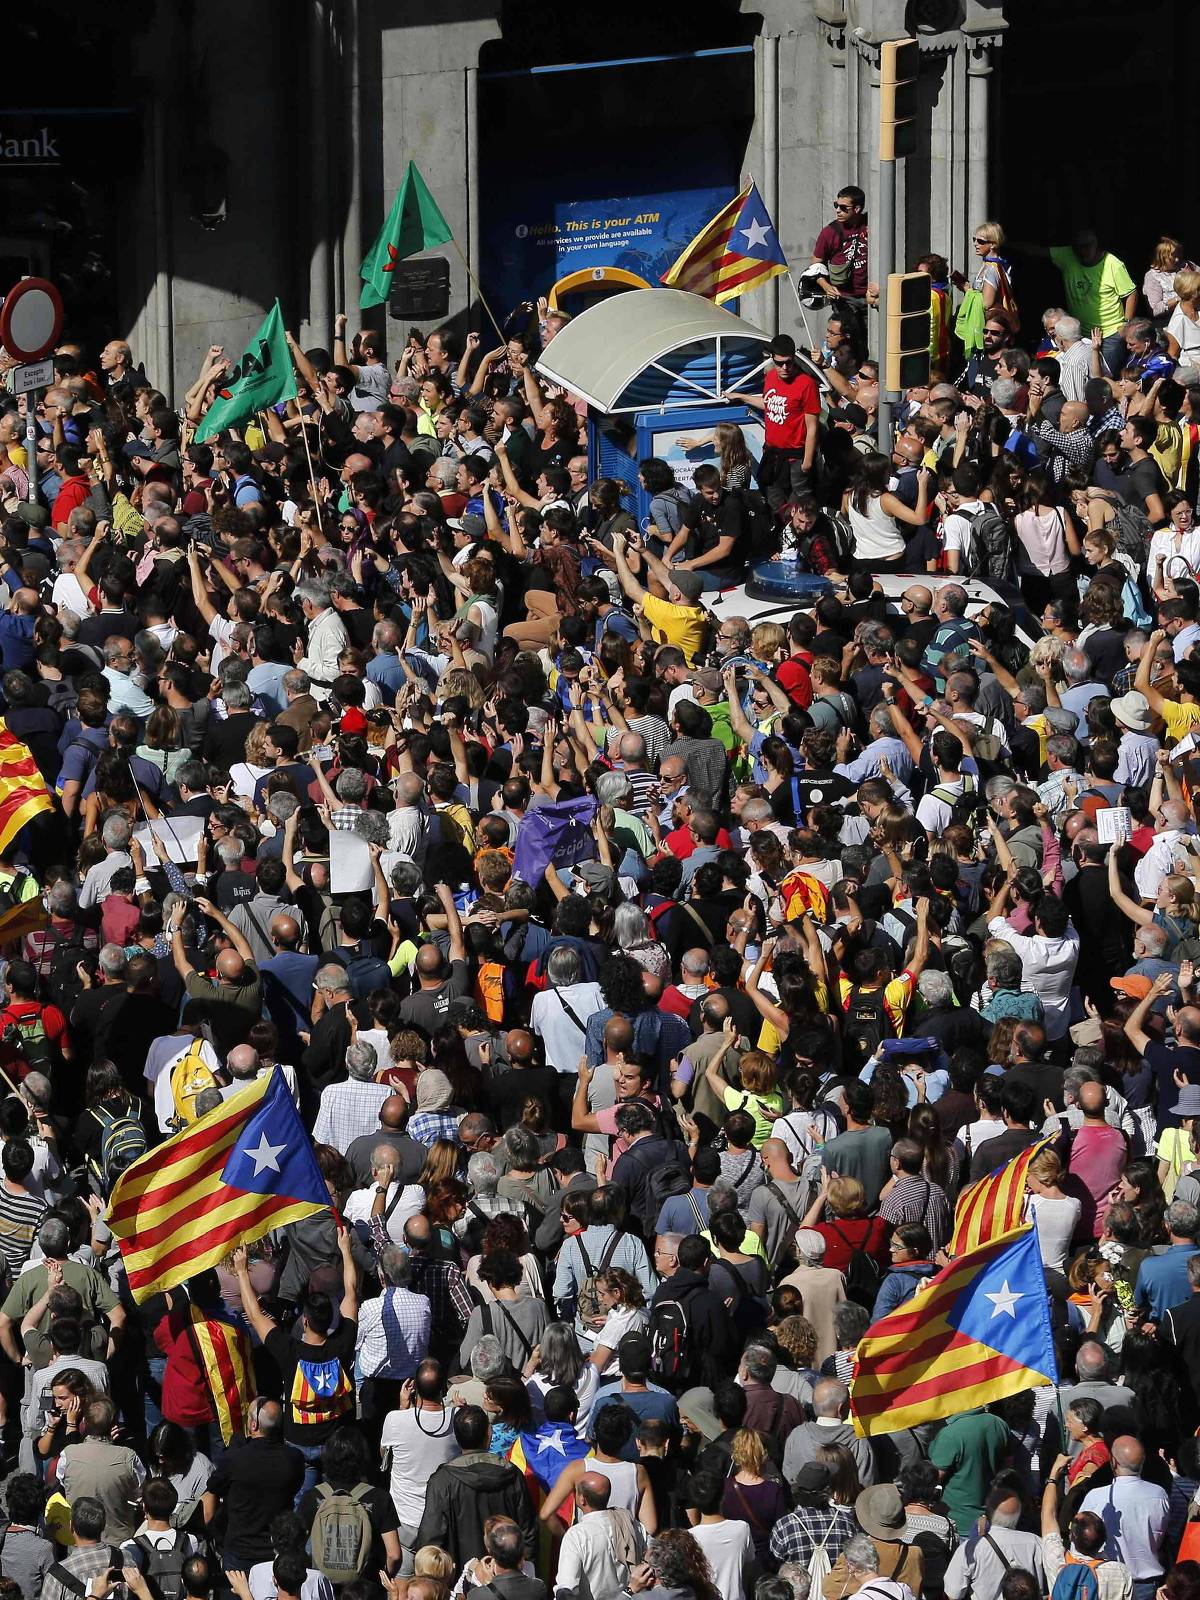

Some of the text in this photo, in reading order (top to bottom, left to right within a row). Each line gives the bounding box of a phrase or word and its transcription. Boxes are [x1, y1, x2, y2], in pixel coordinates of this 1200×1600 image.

[566, 221, 589, 232] This
[591, 219, 601, 229] is
[604, 217, 632, 230] your
[634, 212, 660, 224] ATM
[536, 228, 653, 246] All services we provide are available
[558, 239, 629, 253] in your own language
